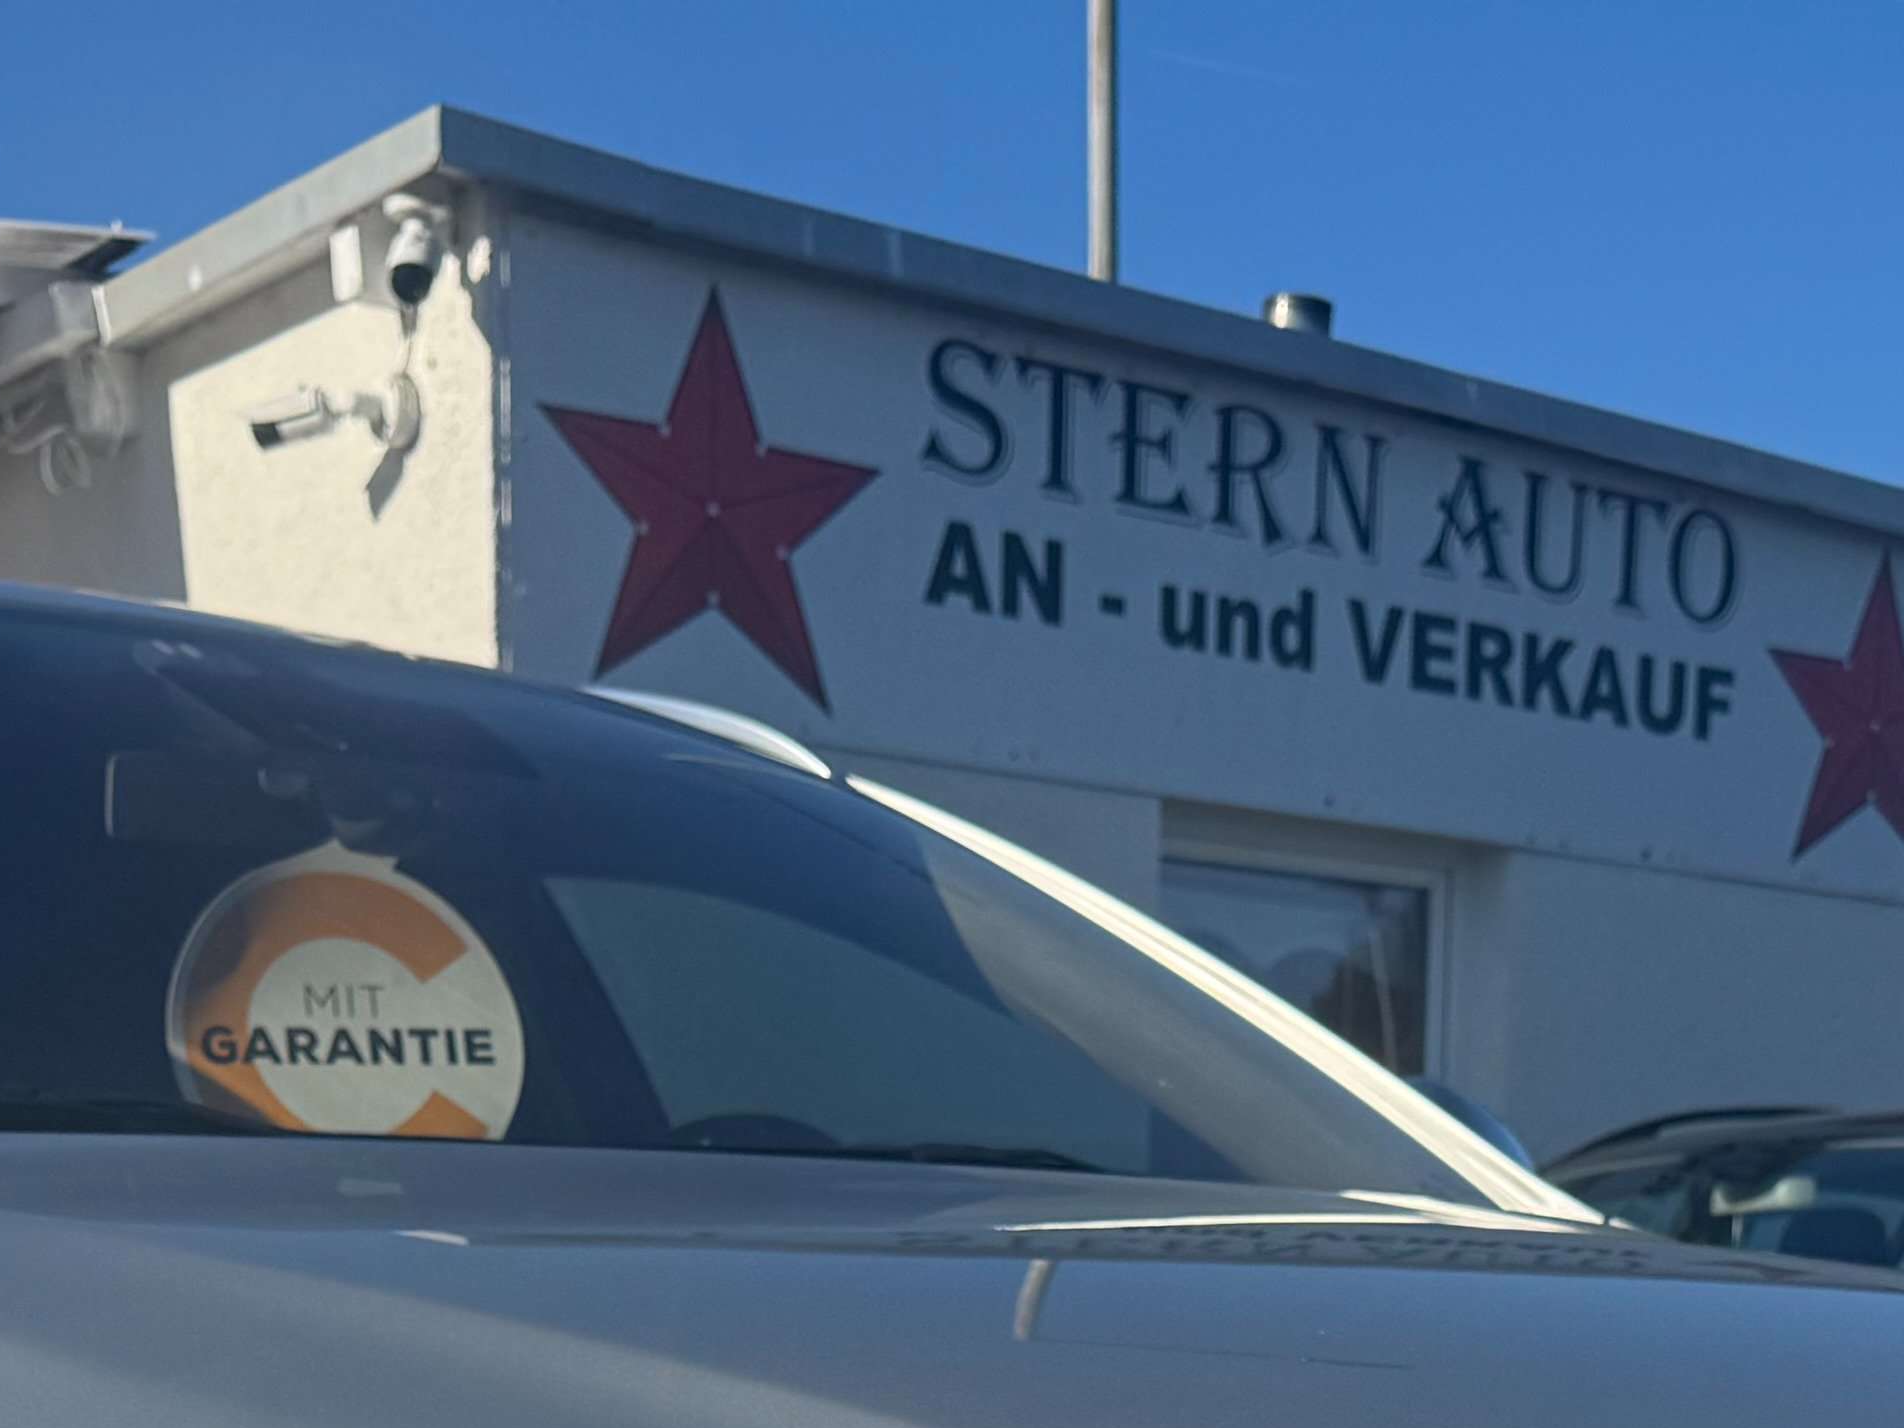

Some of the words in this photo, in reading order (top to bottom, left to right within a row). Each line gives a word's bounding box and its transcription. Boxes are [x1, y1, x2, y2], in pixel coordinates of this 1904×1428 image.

[922, 338, 1390, 560] STERN
[1422, 455, 1740, 632] AUTO
[923, 518, 1064, 627] AN
[1158, 583, 1316, 674] und
[1347, 596, 1736, 742] VERKAUF
[200, 1025, 496, 1066] GARANTIE
[302, 983, 385, 1018] MIT
